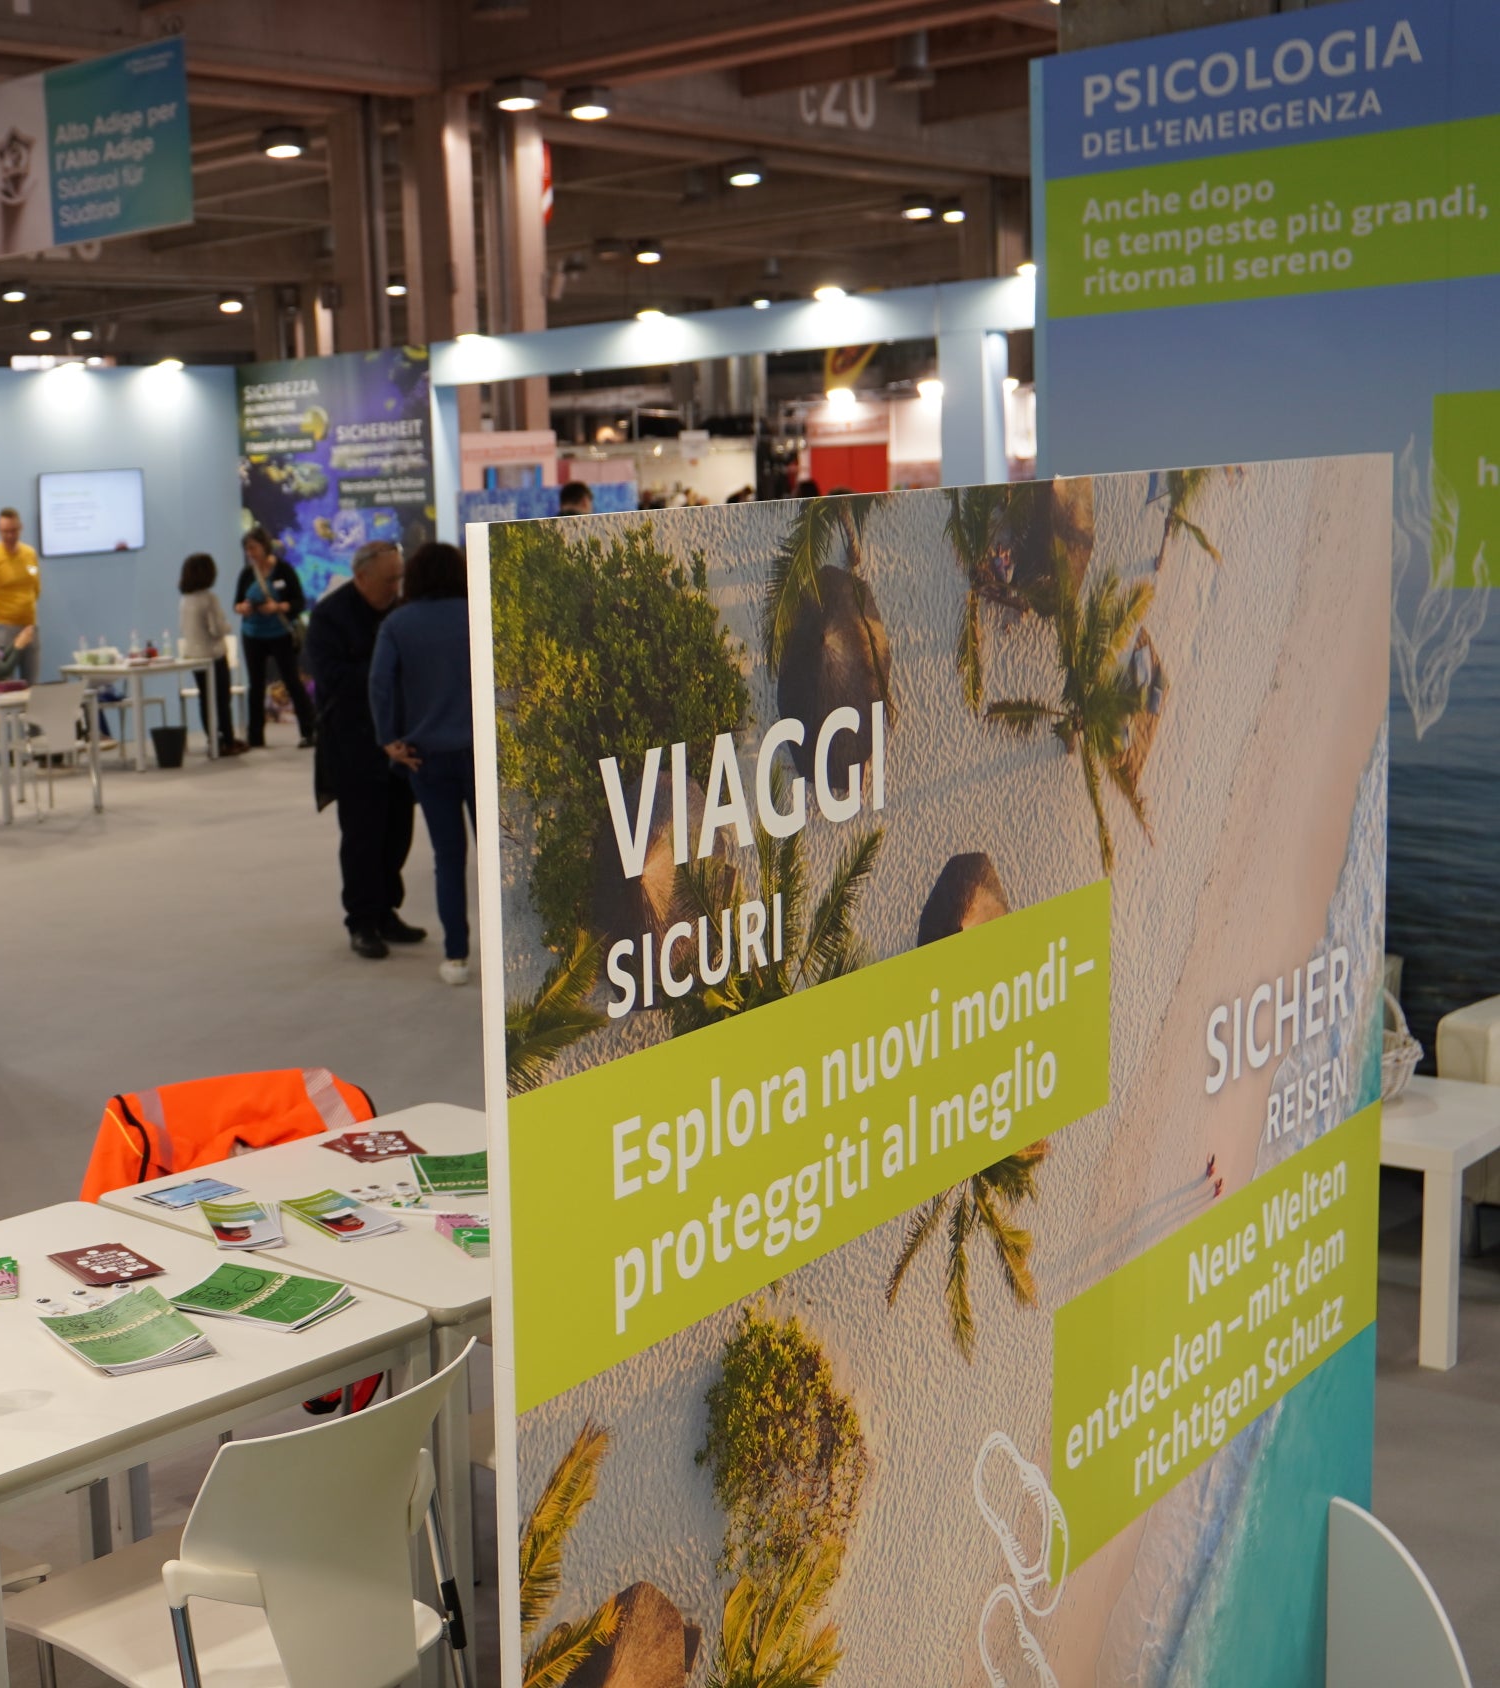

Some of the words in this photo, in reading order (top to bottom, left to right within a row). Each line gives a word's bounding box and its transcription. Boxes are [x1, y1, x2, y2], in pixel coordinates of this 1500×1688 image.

[1083, 20, 1423, 117] PSICOLOGIA
[55, 123, 90, 144] Alto
[93, 110, 143, 134] Adige
[147, 102, 177, 127] per
[103, 136, 155, 160] Adige
[1082, 88, 1382, 159] DELL'EMERGENZA
[58, 167, 119, 199] Südtirol
[59, 196, 121, 227] Südtirol
[1081, 189, 1181, 225] Anche
[1189, 179, 1275, 211] dopo
[1083, 233, 1110, 260] le
[1118, 215, 1278, 255] tempeste
[1287, 201, 1342, 242] più
[1351, 183, 1489, 237] grandi,
[1083, 262, 1196, 296] ritorna
[1205, 253, 1225, 284] il
[1232, 247, 1354, 281] sereno
[243, 379, 319, 400] SICUREZZA
[336, 419, 423, 441] SICHERHEIT
[598, 700, 887, 880] VIAGGI
[606, 892, 784, 1019] SICURI
[1205, 945, 1350, 1094] SICHER
[611, 1065, 807, 1200] Esplora
[821, 988, 940, 1108] nuovi
[1266, 1056, 1348, 1144] REISEN
[613, 1117, 870, 1335] proteggiti
[881, 1097, 918, 1178] al
[930, 1040, 1057, 1154] meglio
[1187, 1223, 1256, 1304] Neue
[1262, 1160, 1346, 1245] Welten
[1065, 1319, 1222, 1470] entdecken
[1248, 1268, 1291, 1334] mit
[1295, 1228, 1345, 1298] dem
[1133, 1366, 1258, 1497] richtigen
[1263, 1295, 1344, 1388] Schutz
